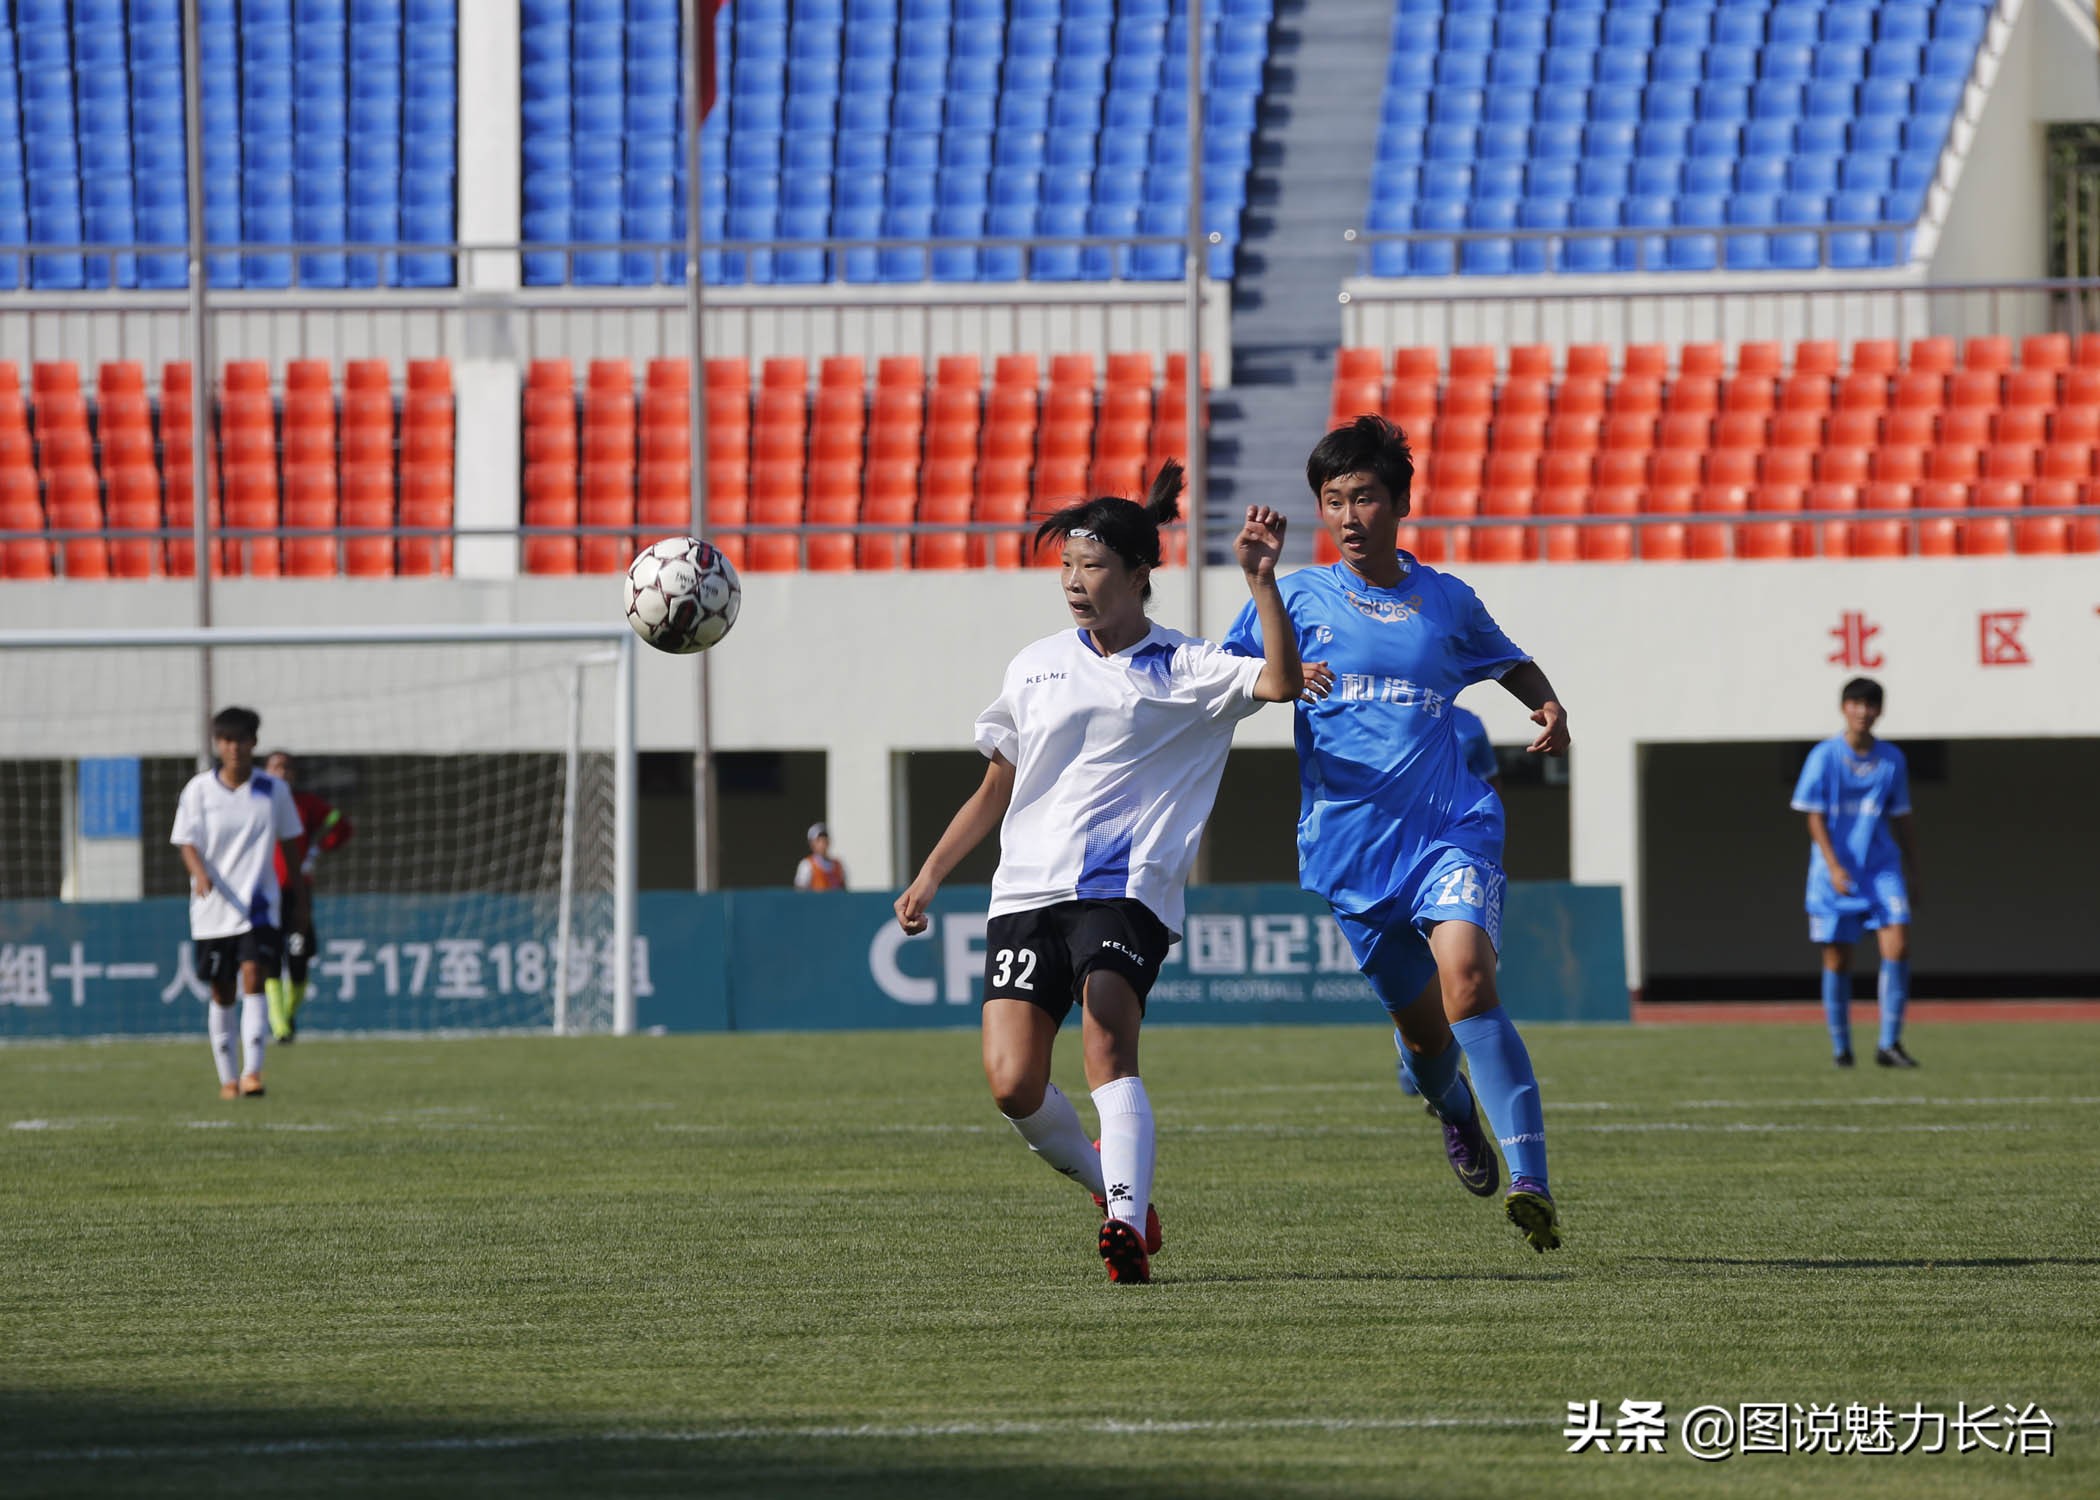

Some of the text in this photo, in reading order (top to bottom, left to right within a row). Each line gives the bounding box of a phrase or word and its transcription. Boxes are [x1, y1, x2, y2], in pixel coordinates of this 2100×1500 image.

[1025, 671, 1069, 684] KELME
[1436, 865, 1484, 908] 26
[1102, 939, 1145, 966] KELME
[992, 948, 1037, 990] 32
[1208, 981, 1304, 1001] FOOTBALL
